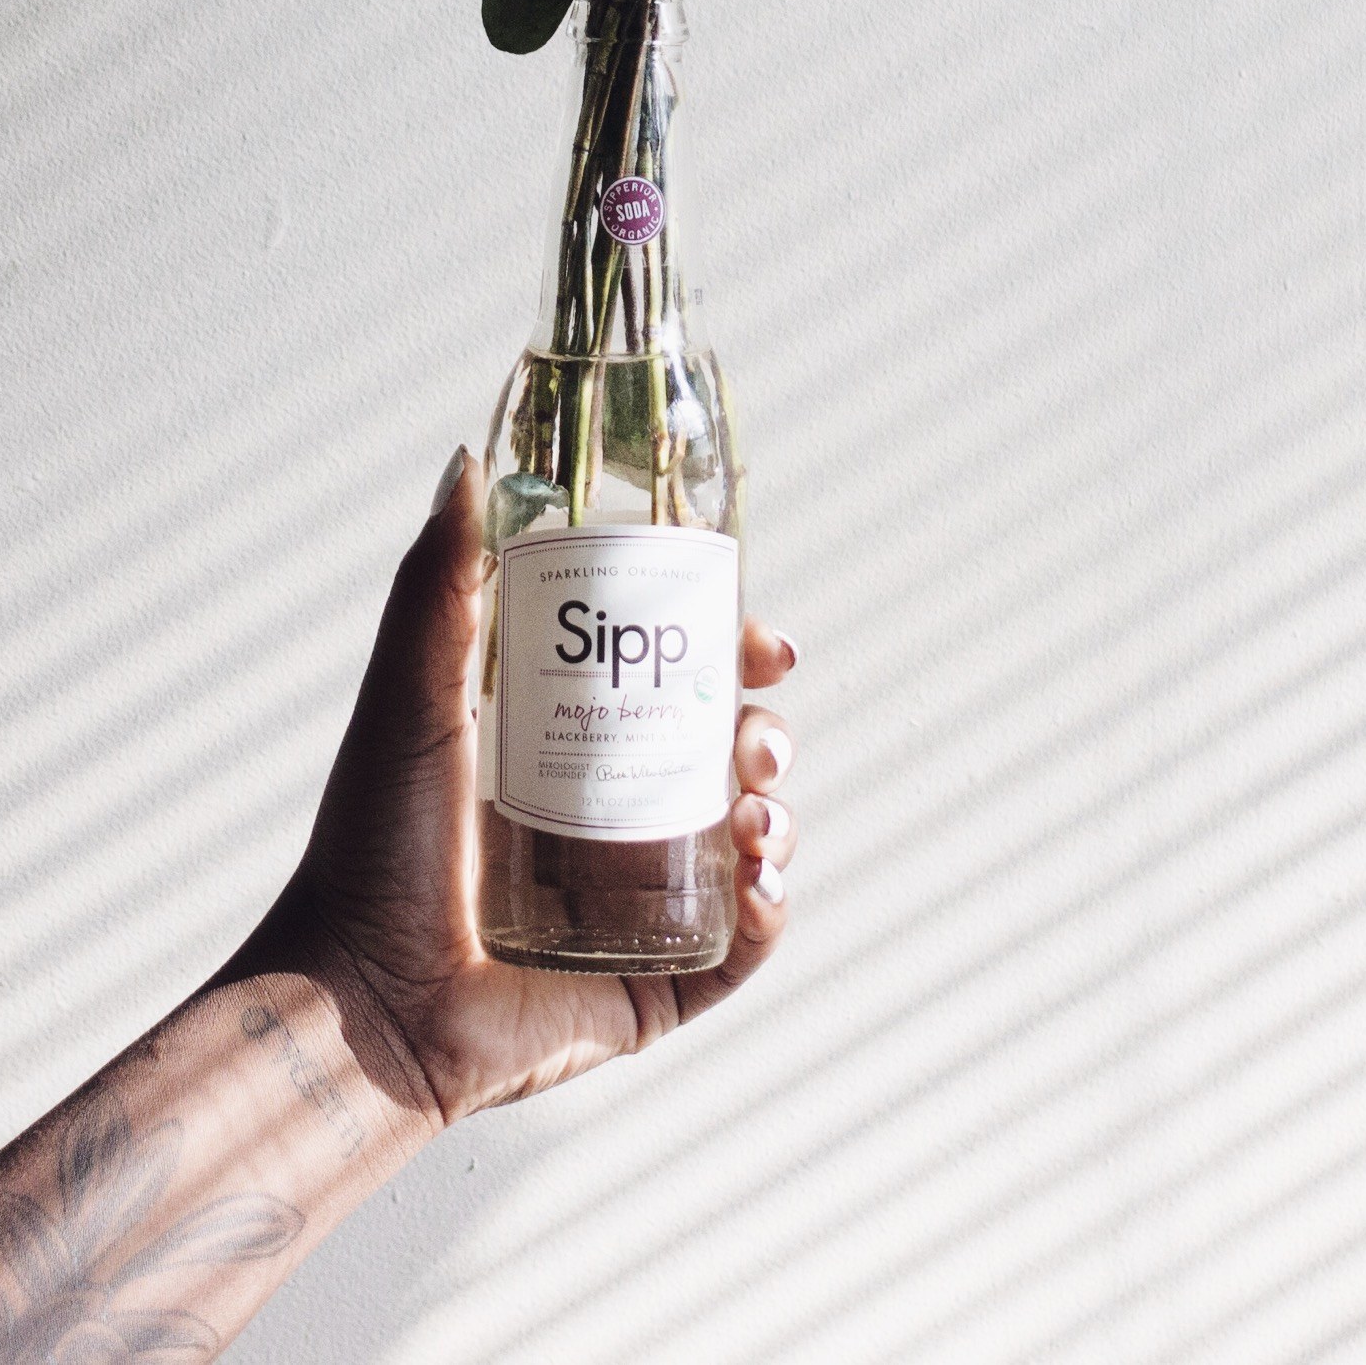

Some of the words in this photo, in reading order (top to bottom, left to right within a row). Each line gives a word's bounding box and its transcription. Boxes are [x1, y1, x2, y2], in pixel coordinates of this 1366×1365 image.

[604, 182, 657, 213] SIPPERIOR
[615, 199, 651, 222] SODA
[611, 216, 659, 240] ORGANIC
[540, 566, 619, 583] SPARKLING
[627, 566, 702, 584] ORGANICS
[555, 599, 689, 689] Sipp
[554, 696, 609, 731] mojo
[617, 693, 686, 731] berry
[545, 730, 620, 744] BLACKBERRY,
[625, 732, 655, 742] MINT
[538, 760, 590, 771] MIXOLOGIST
[546, 770, 587, 780] FOUNDER
[580, 796, 593, 806] 12
[595, 796, 605, 807] FL
[607, 797, 624, 807] OZ
